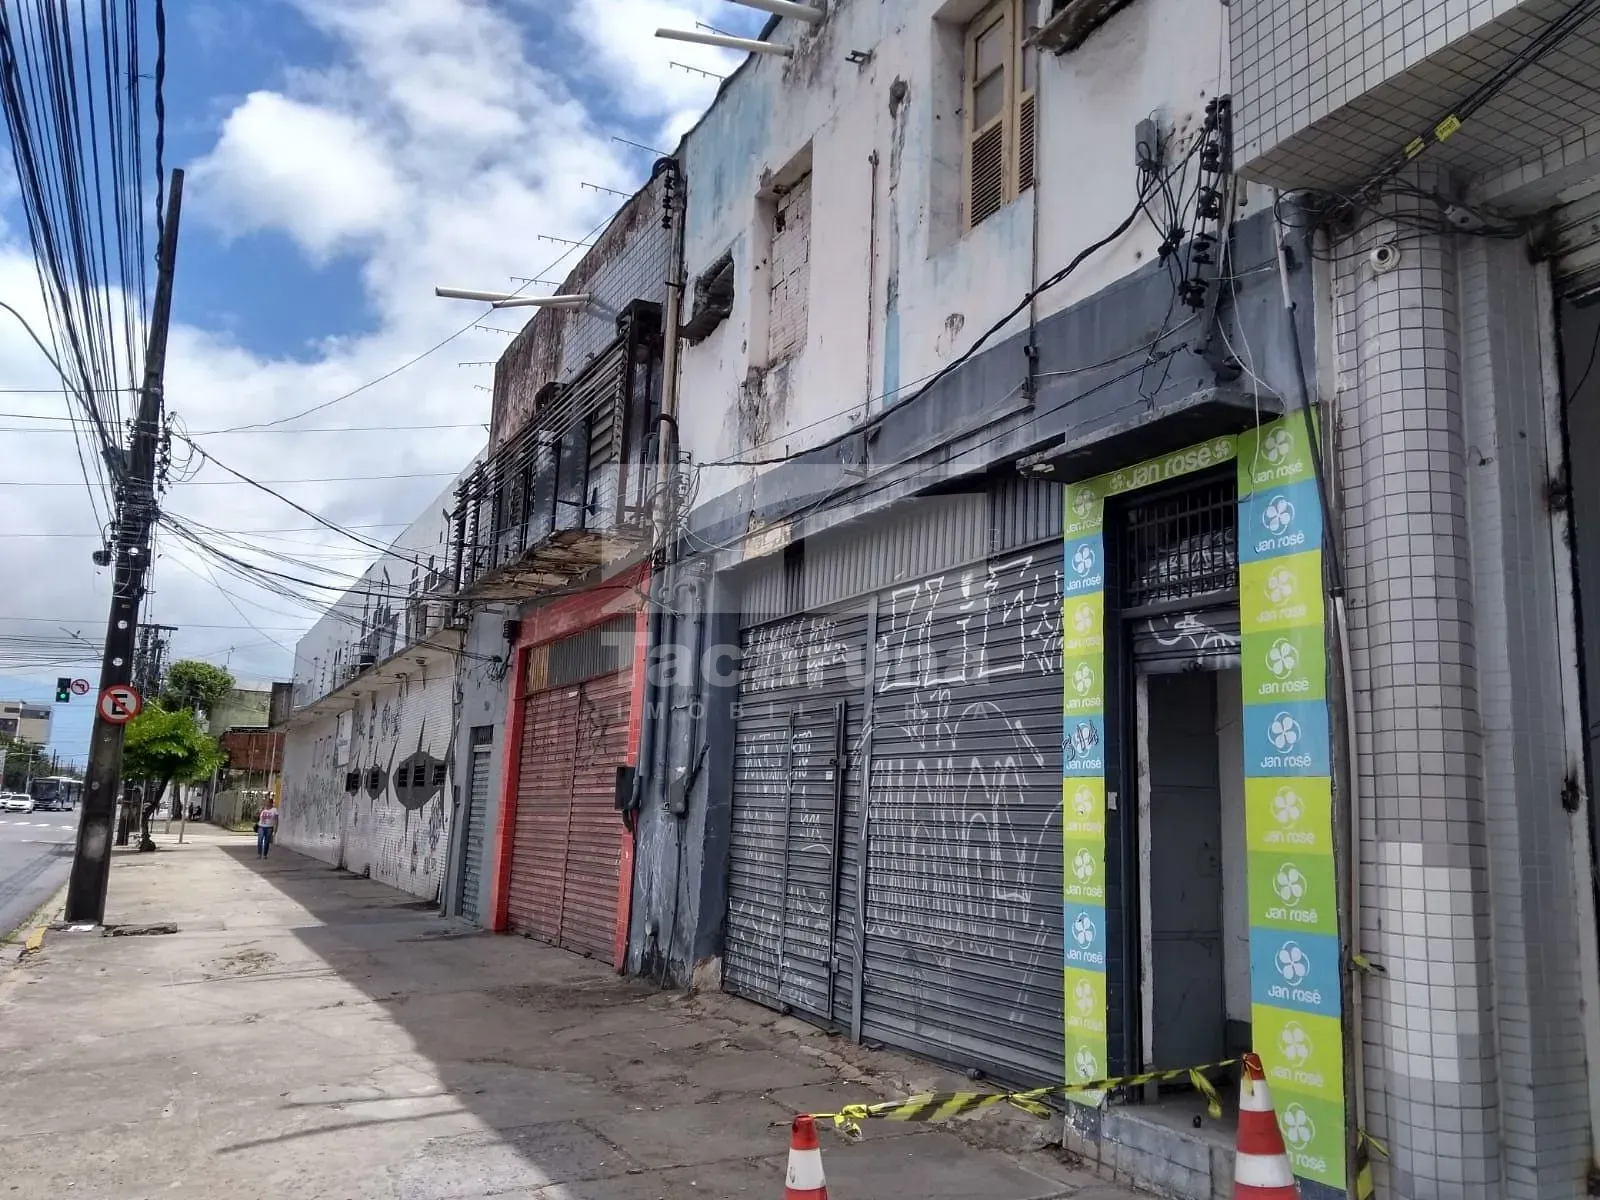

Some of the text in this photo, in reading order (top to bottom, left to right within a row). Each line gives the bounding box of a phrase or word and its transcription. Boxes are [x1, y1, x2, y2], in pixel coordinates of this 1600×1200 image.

[1127, 464, 1160, 488] Jan
[1255, 530, 1305, 553] Jan rosé
[1258, 681, 1279, 695] Jan
[112, 693, 128, 715] E
[1261, 756, 1281, 768] Jan
[1265, 907, 1286, 920] Jan
[1268, 988, 1290, 1000] Jan
